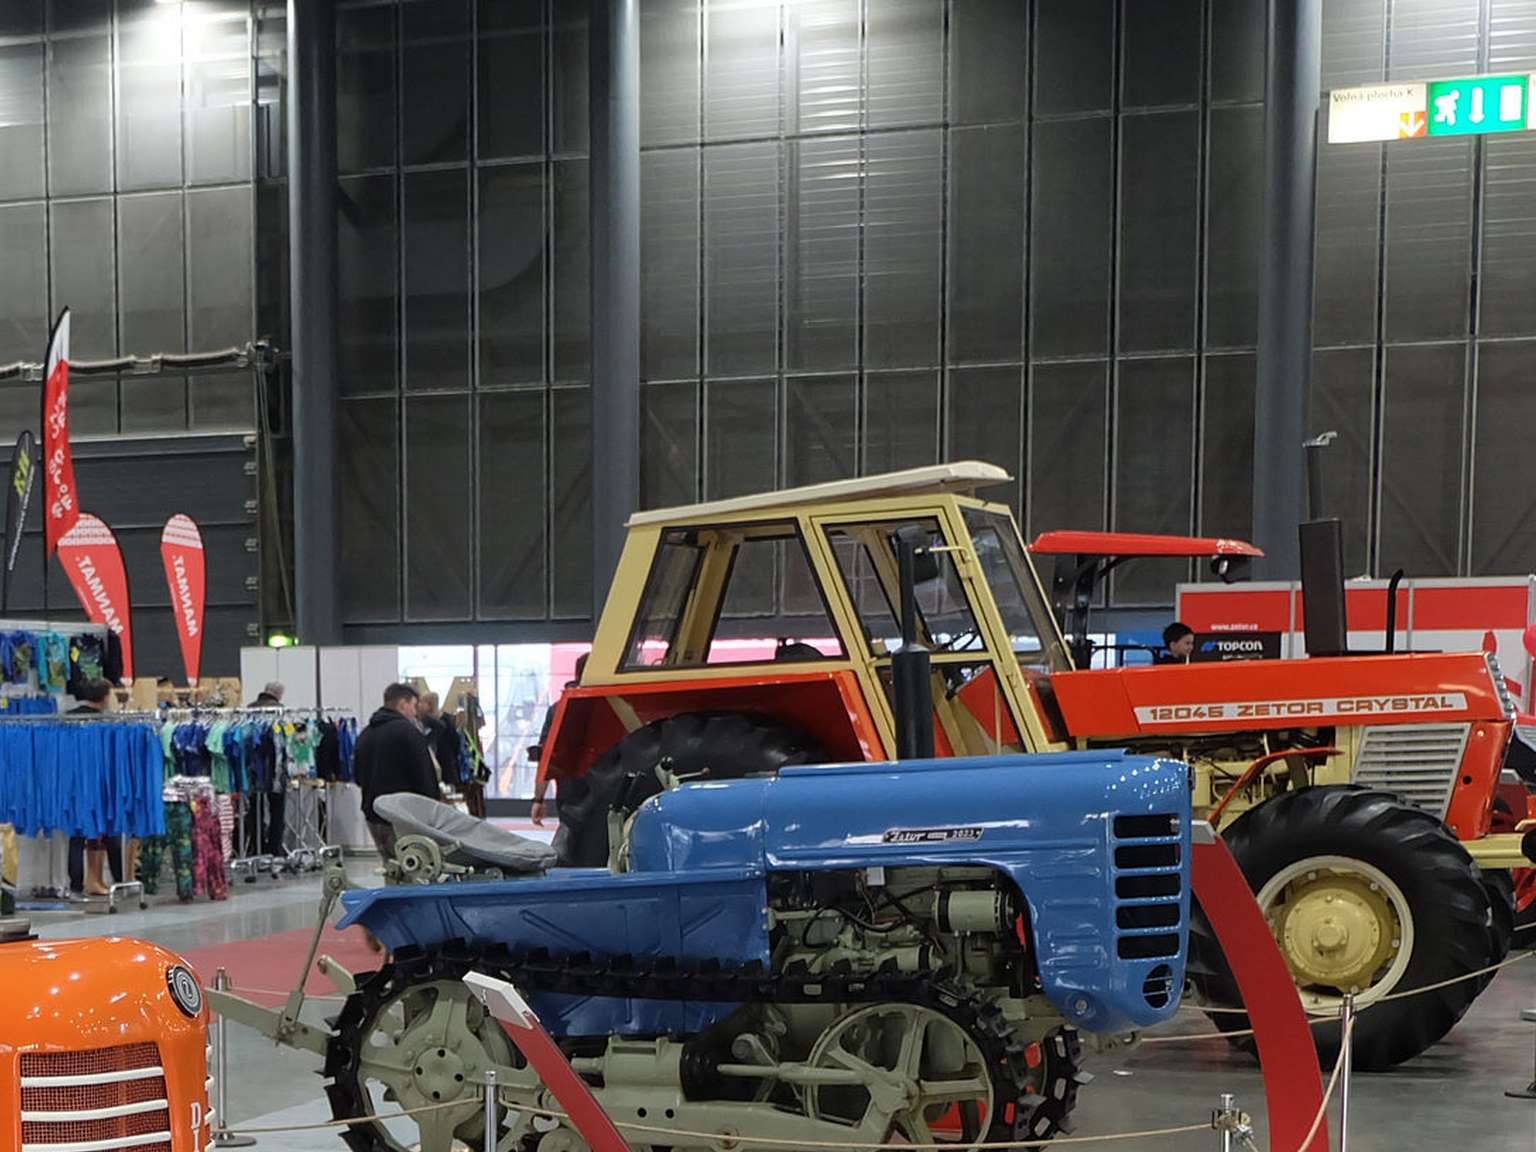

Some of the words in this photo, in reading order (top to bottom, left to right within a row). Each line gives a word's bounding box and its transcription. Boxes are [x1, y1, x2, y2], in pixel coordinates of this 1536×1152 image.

[1217, 641, 1263, 652] TOPCON
[1150, 705, 1224, 721] 12045
[1237, 702, 1324, 717] ZETOR
[1336, 695, 1454, 713] CRYSTAL
